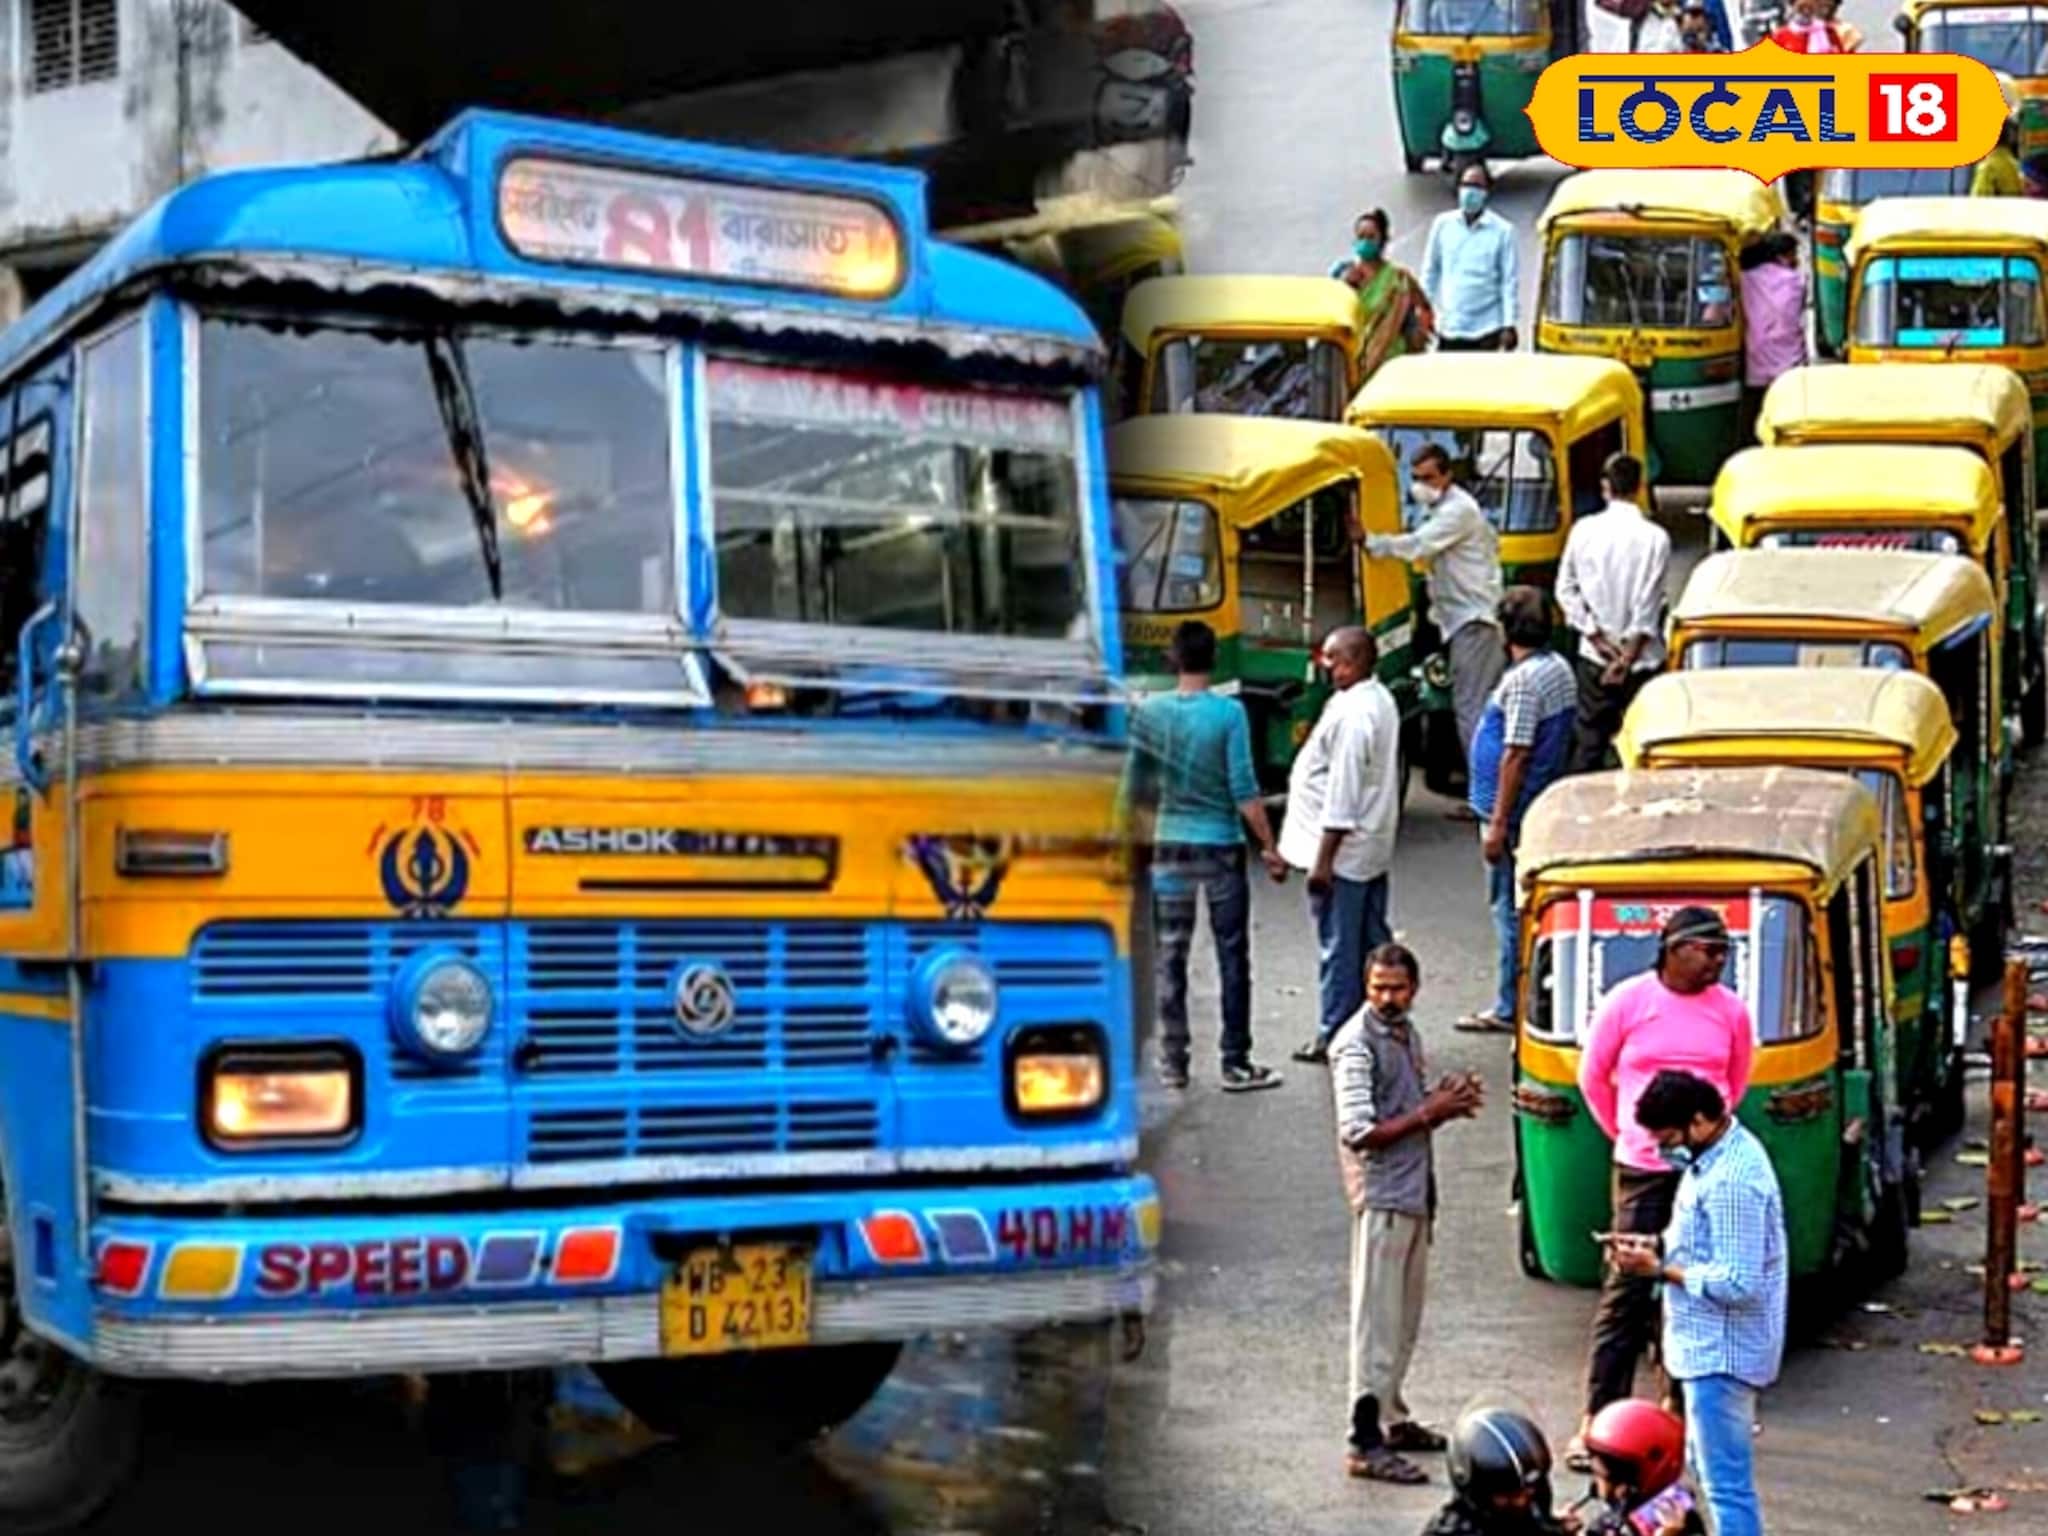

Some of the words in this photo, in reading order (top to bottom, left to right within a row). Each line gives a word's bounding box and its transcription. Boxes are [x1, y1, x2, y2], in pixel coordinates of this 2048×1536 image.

[531, 827, 680, 853] ASHOK
[254, 1235, 472, 1296] SPEED
[751, 1255, 788, 1293] 23
